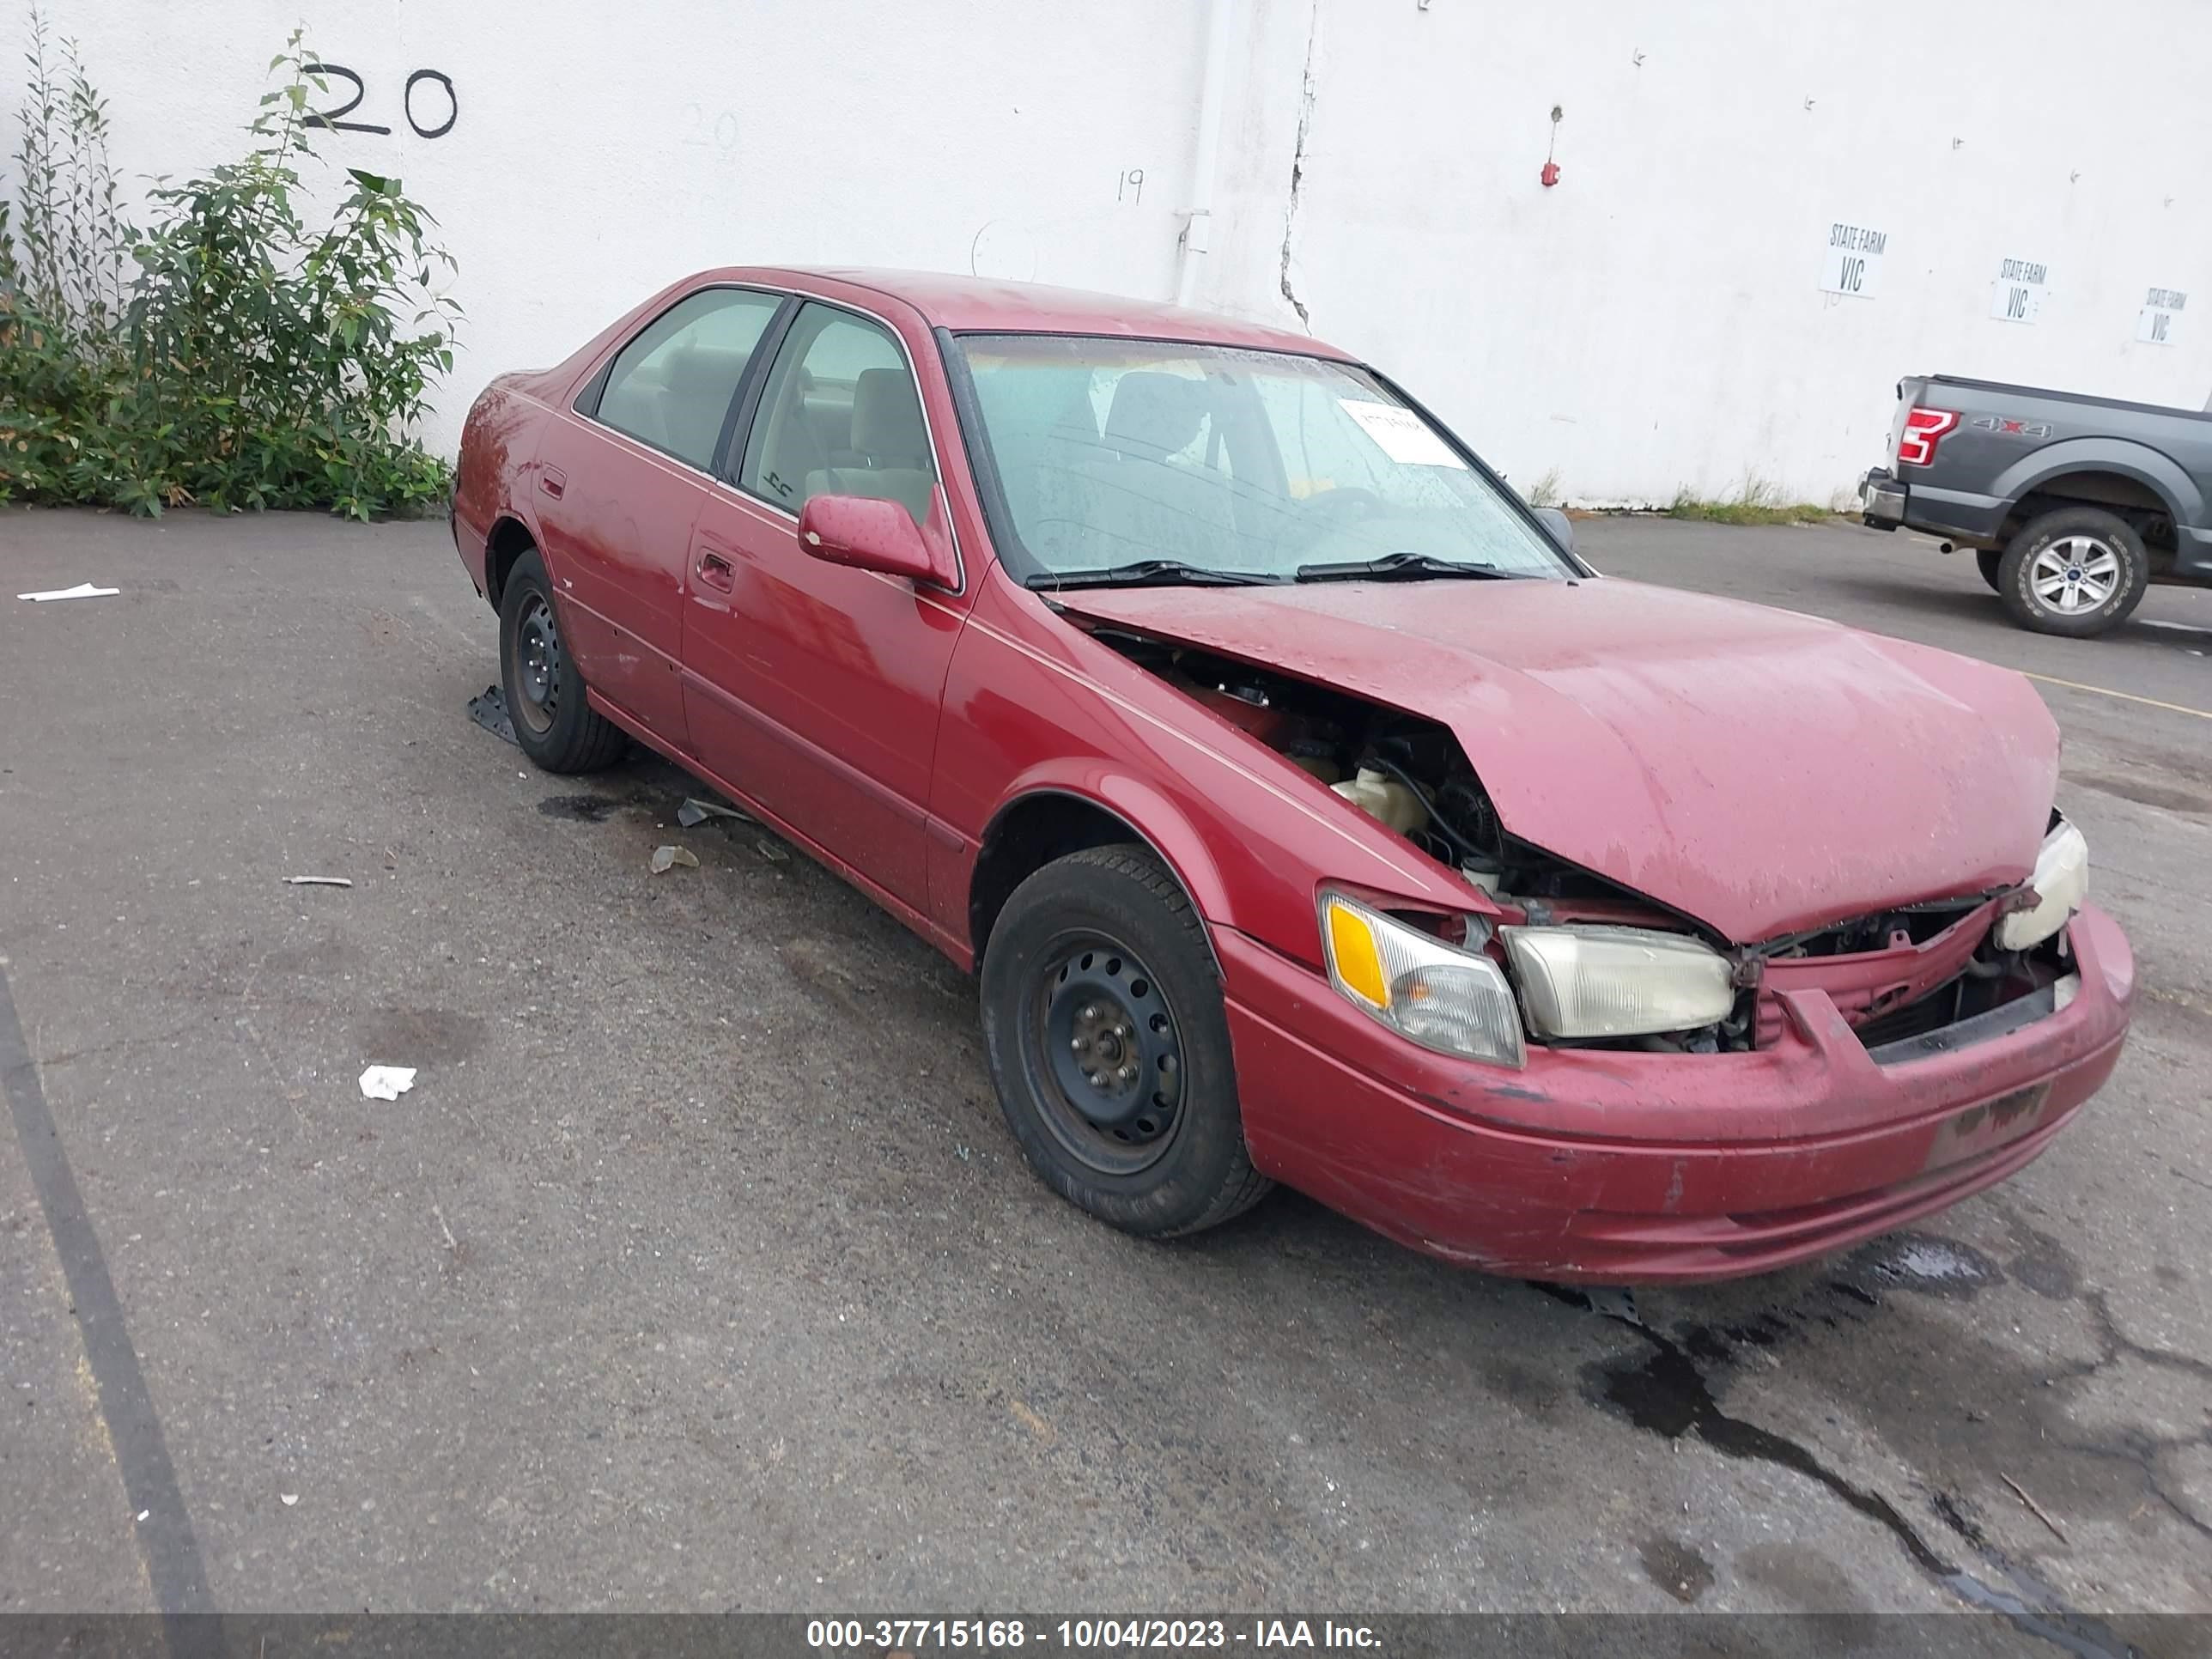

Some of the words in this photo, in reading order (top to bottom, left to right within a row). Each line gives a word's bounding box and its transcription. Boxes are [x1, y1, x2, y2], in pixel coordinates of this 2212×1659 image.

[301, 64, 458, 139] 20
[1118, 168, 1144, 206] 19
[1830, 222, 1859, 250] STATE
[1857, 228, 1887, 255] FARM
[1839, 256, 1864, 292] VIC
[2001, 258, 2025, 282] STATE
[2022, 262, 2047, 285] FARM
[2007, 287, 2028, 319] VIC
[2151, 313, 2170, 341] VIC
